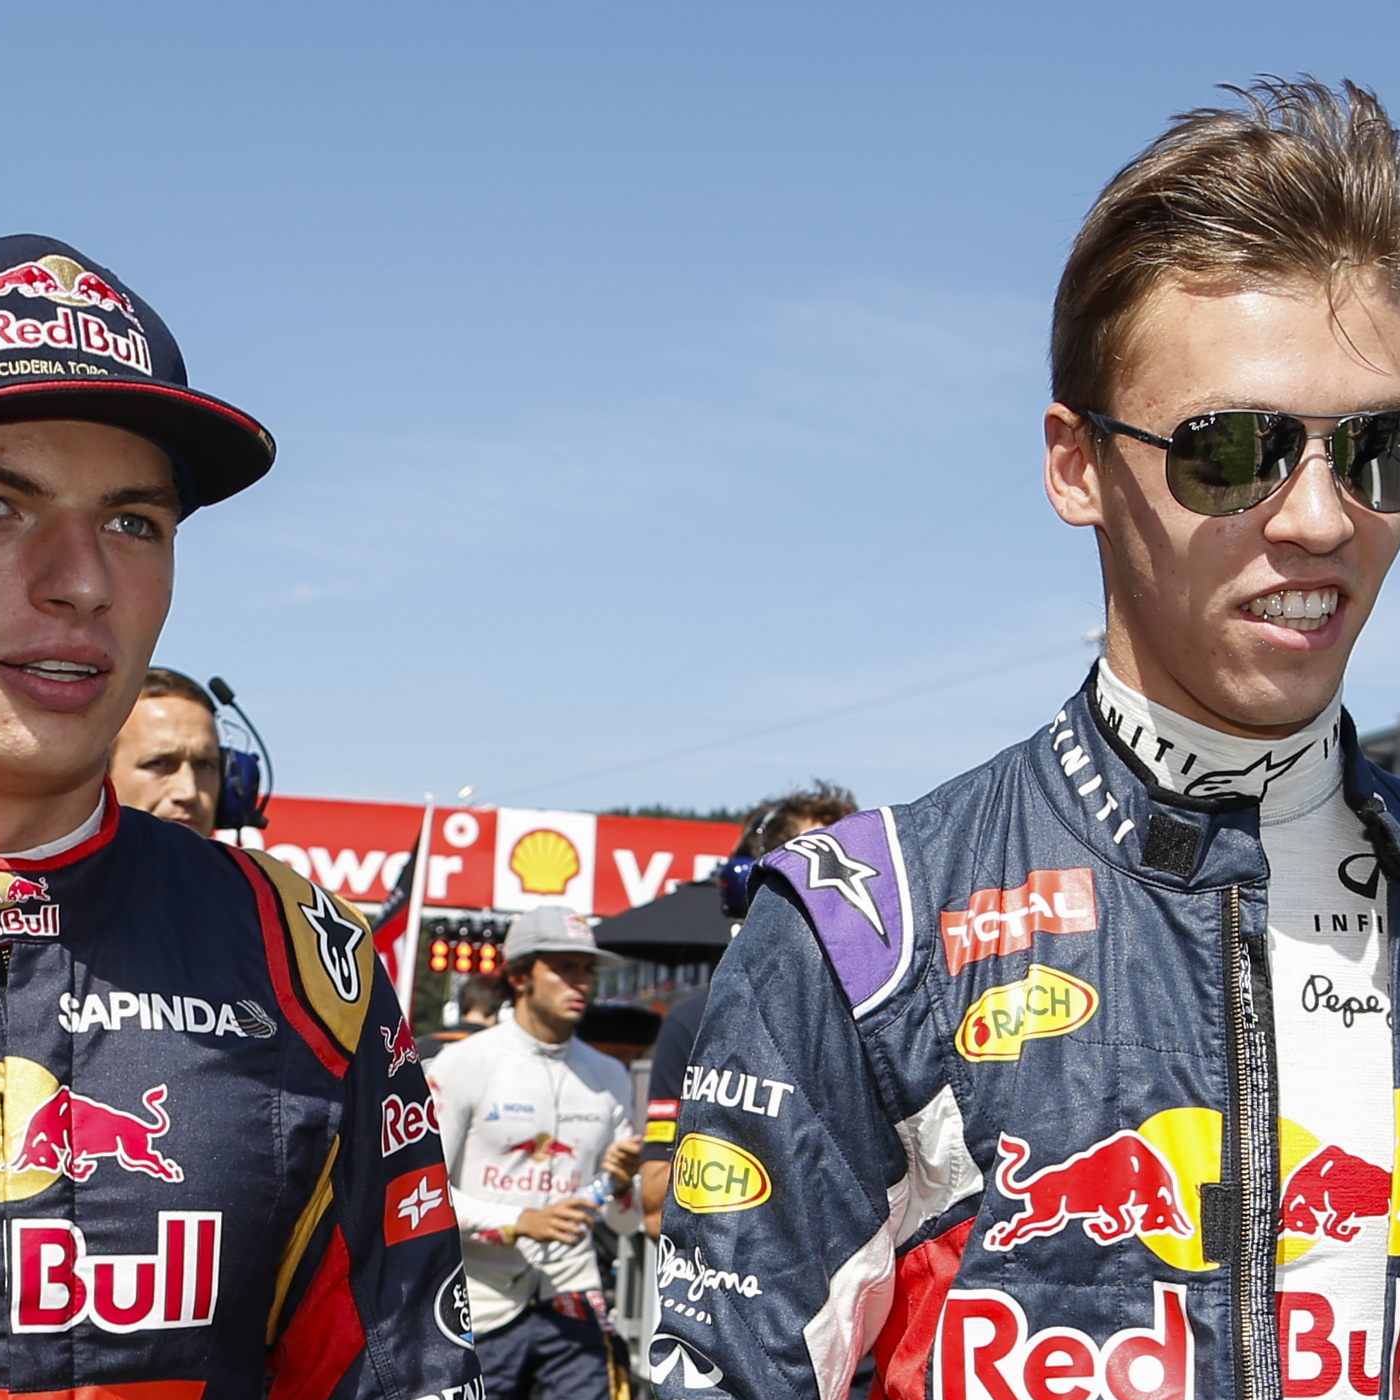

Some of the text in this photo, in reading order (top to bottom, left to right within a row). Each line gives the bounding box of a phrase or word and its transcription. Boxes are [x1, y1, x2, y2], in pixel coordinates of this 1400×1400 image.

[77, 311, 152, 376] Bull
[1100, 695, 1197, 775] NITI
[0, 905, 60, 938] Bull
[58, 991, 245, 1037] SAPINDA
[991, 984, 1071, 1040] RACH
[1302, 974, 1384, 1028] Pepe
[483, 1165, 582, 1195] Red Bull
[9, 1211, 223, 1335] Bull
